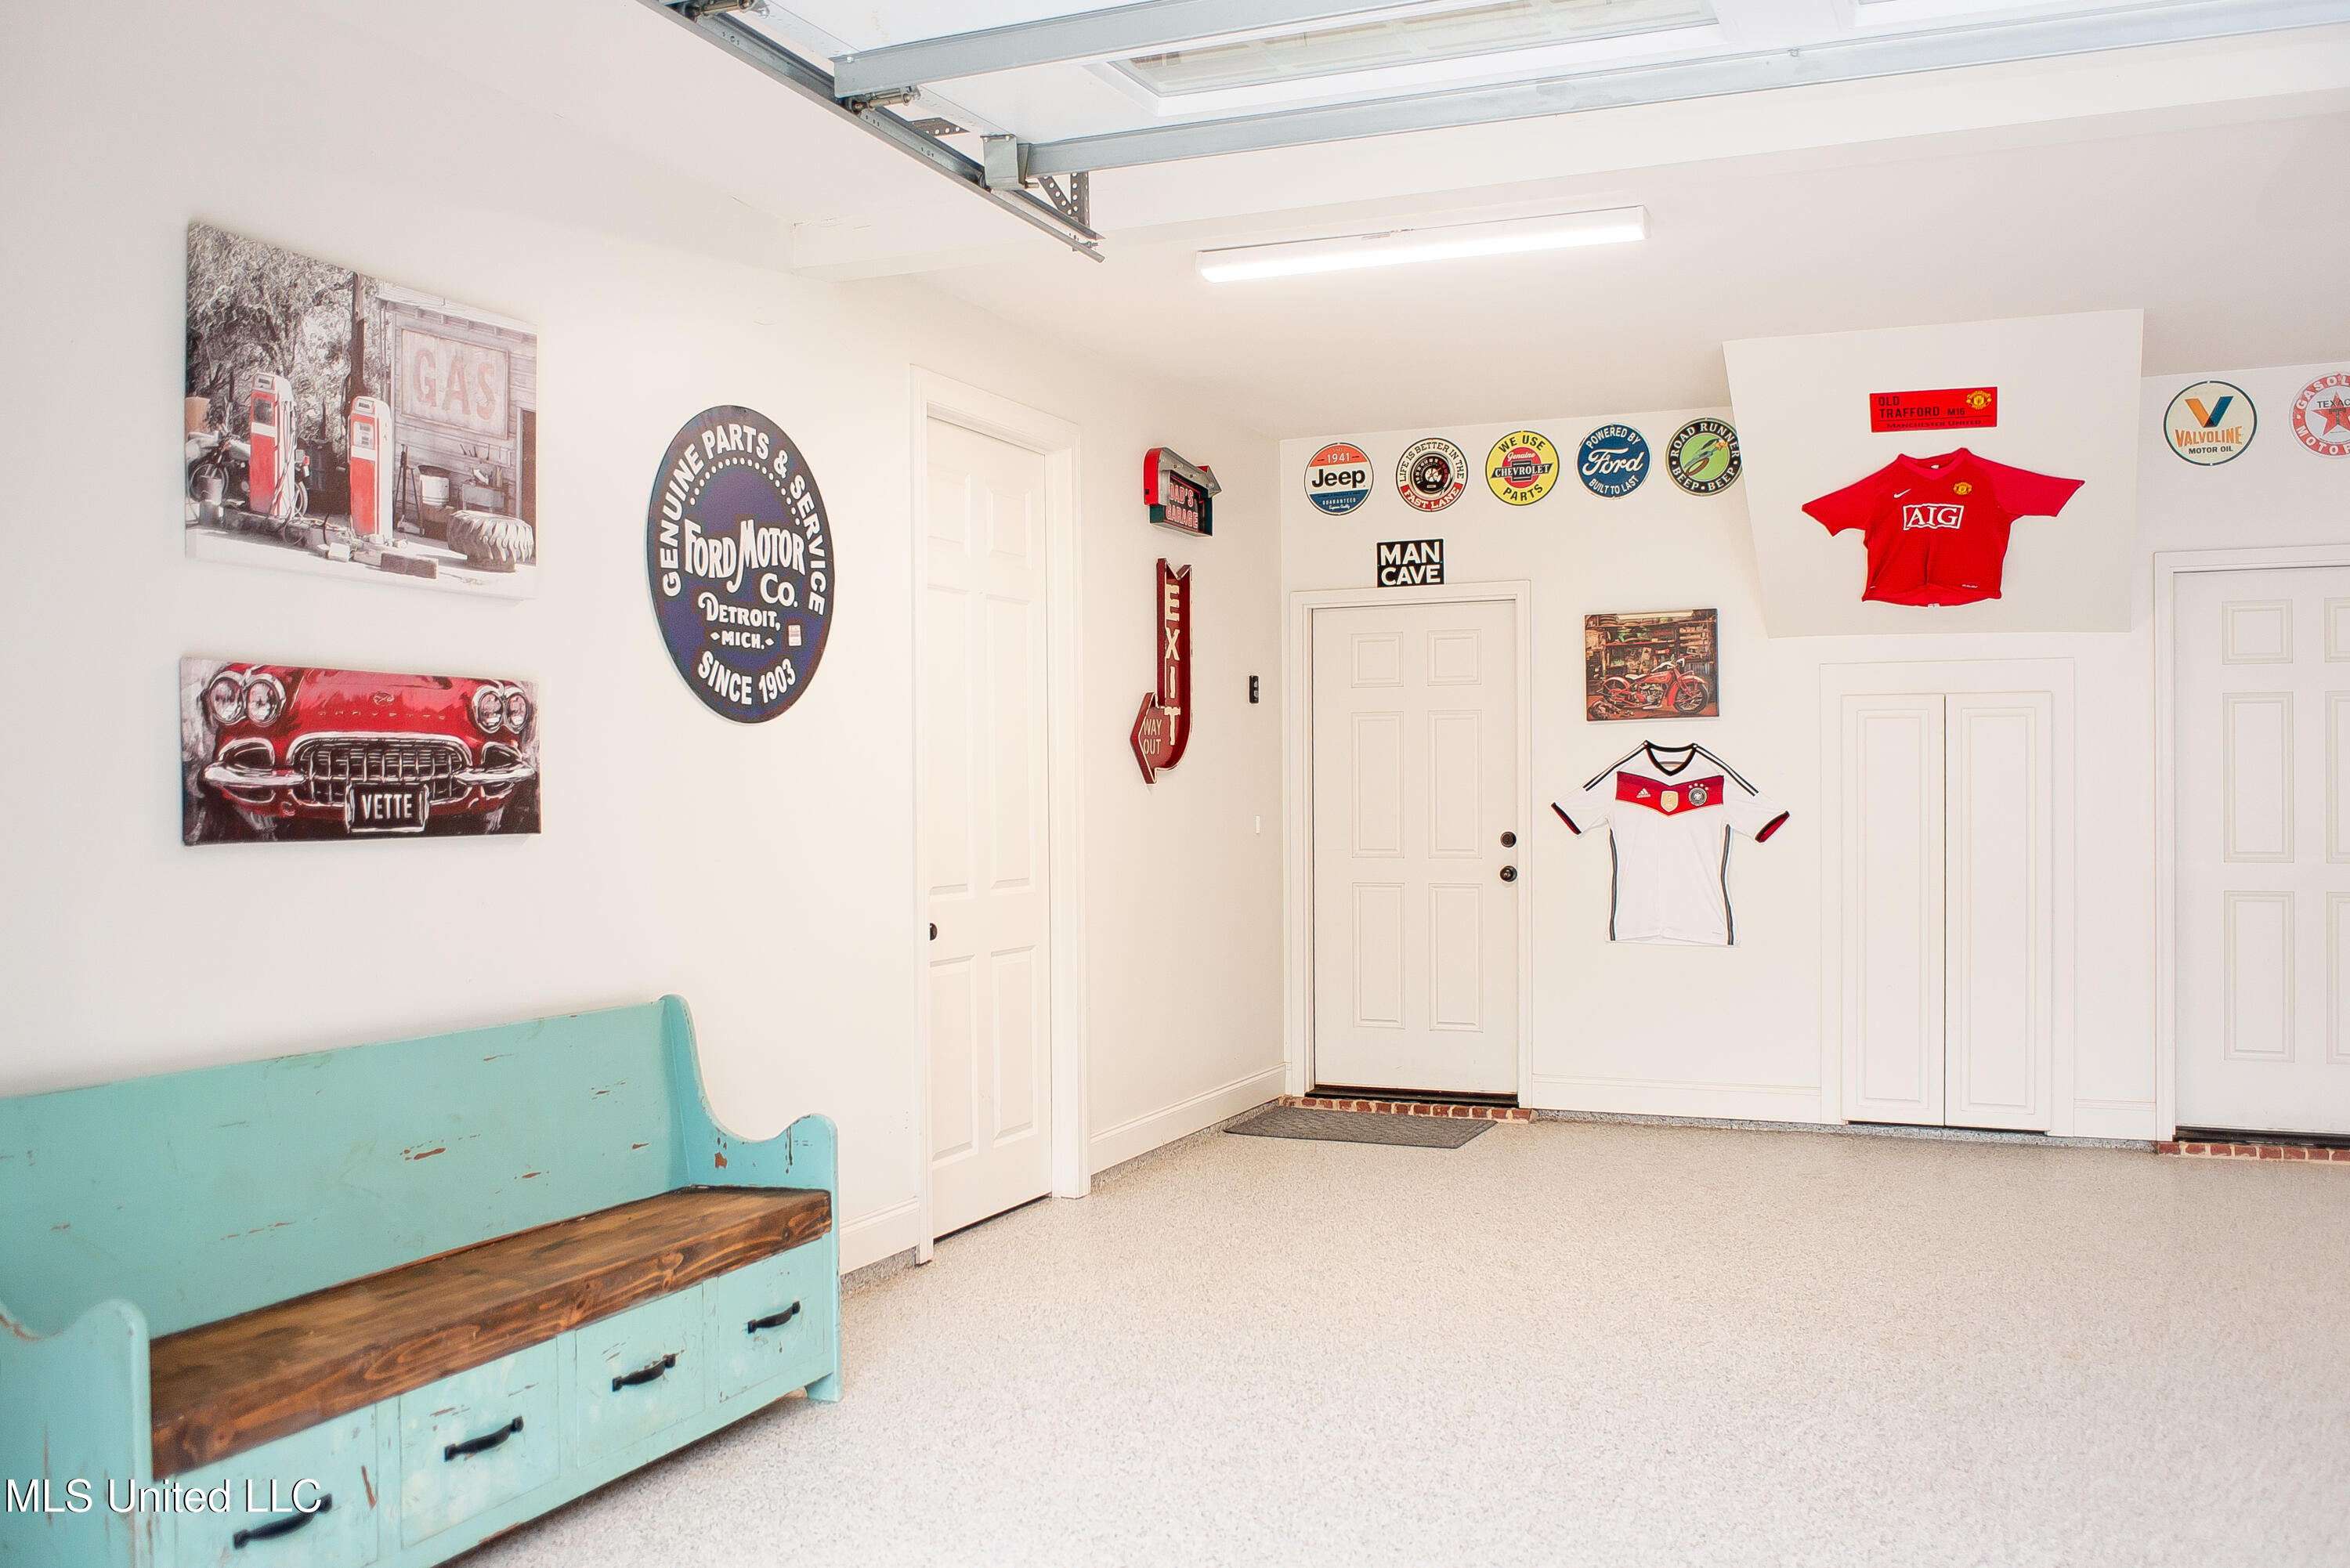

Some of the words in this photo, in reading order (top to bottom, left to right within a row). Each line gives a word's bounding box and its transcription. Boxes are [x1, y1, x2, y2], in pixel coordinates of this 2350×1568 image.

[413, 347, 495, 421] GAS
[1878, 396, 1900, 406] OLD
[1879, 406, 1940, 418] TRAFFORD
[1947, 407, 1965, 416] M16
[1499, 436, 1517, 453] WE
[1522, 435, 1546, 450] USE
[1585, 427, 1628, 449] POWERED
[1627, 432, 1642, 445] BY
[1670, 426, 1695, 457] ROAD
[1700, 423, 1740, 457] RUNNER
[2175, 425, 2243, 448] VALVOLINE
[1327, 452, 1350, 464] 1941
[1400, 461, 1409, 482] LIFE
[1406, 451, 1415, 461] IS
[1415, 442, 1450, 453] BETTER
[1449, 449, 1459, 460] IN
[1455, 460, 1464, 479] THE
[1507, 451, 1535, 462] Genuine
[1582, 447, 1645, 476] Ford
[1311, 468, 1365, 489] Jeep
[1495, 464, 1549, 477] CHEVROLET
[1672, 466, 1699, 490] BEEP
[1708, 467, 1735, 491] BEEP
[1170, 482, 1194, 508] DAD'S
[1502, 484, 1543, 501] PARTS
[1589, 478, 1609, 494] BUILT
[1611, 485, 1620, 494] TO
[1621, 475, 1640, 492] LAST
[1404, 489, 1429, 508] FAST
[1430, 487, 1460, 509] LANE
[660, 443, 704, 597] GENUINE
[701, 423, 770, 460] PARTS
[773, 449, 789, 479] &
[790, 475, 827, 616] SERVICE
[1166, 503, 1198, 529] GARAGE
[1906, 506, 1958, 527] AIG
[684, 518, 737, 579] FORD
[726, 518, 806, 593] MOTOR
[1380, 541, 1440, 565] MAN
[1381, 565, 1441, 586] CAVE
[721, 630, 765, 649] MICH.
[1165, 583, 1180, 746] EXIT
[698, 650, 752, 705] SINCE
[758, 658, 796, 703] 1903
[1144, 718, 1162, 736] WAY
[1144, 739, 1161, 754] OUT
[361, 793, 413, 820] VETTE
